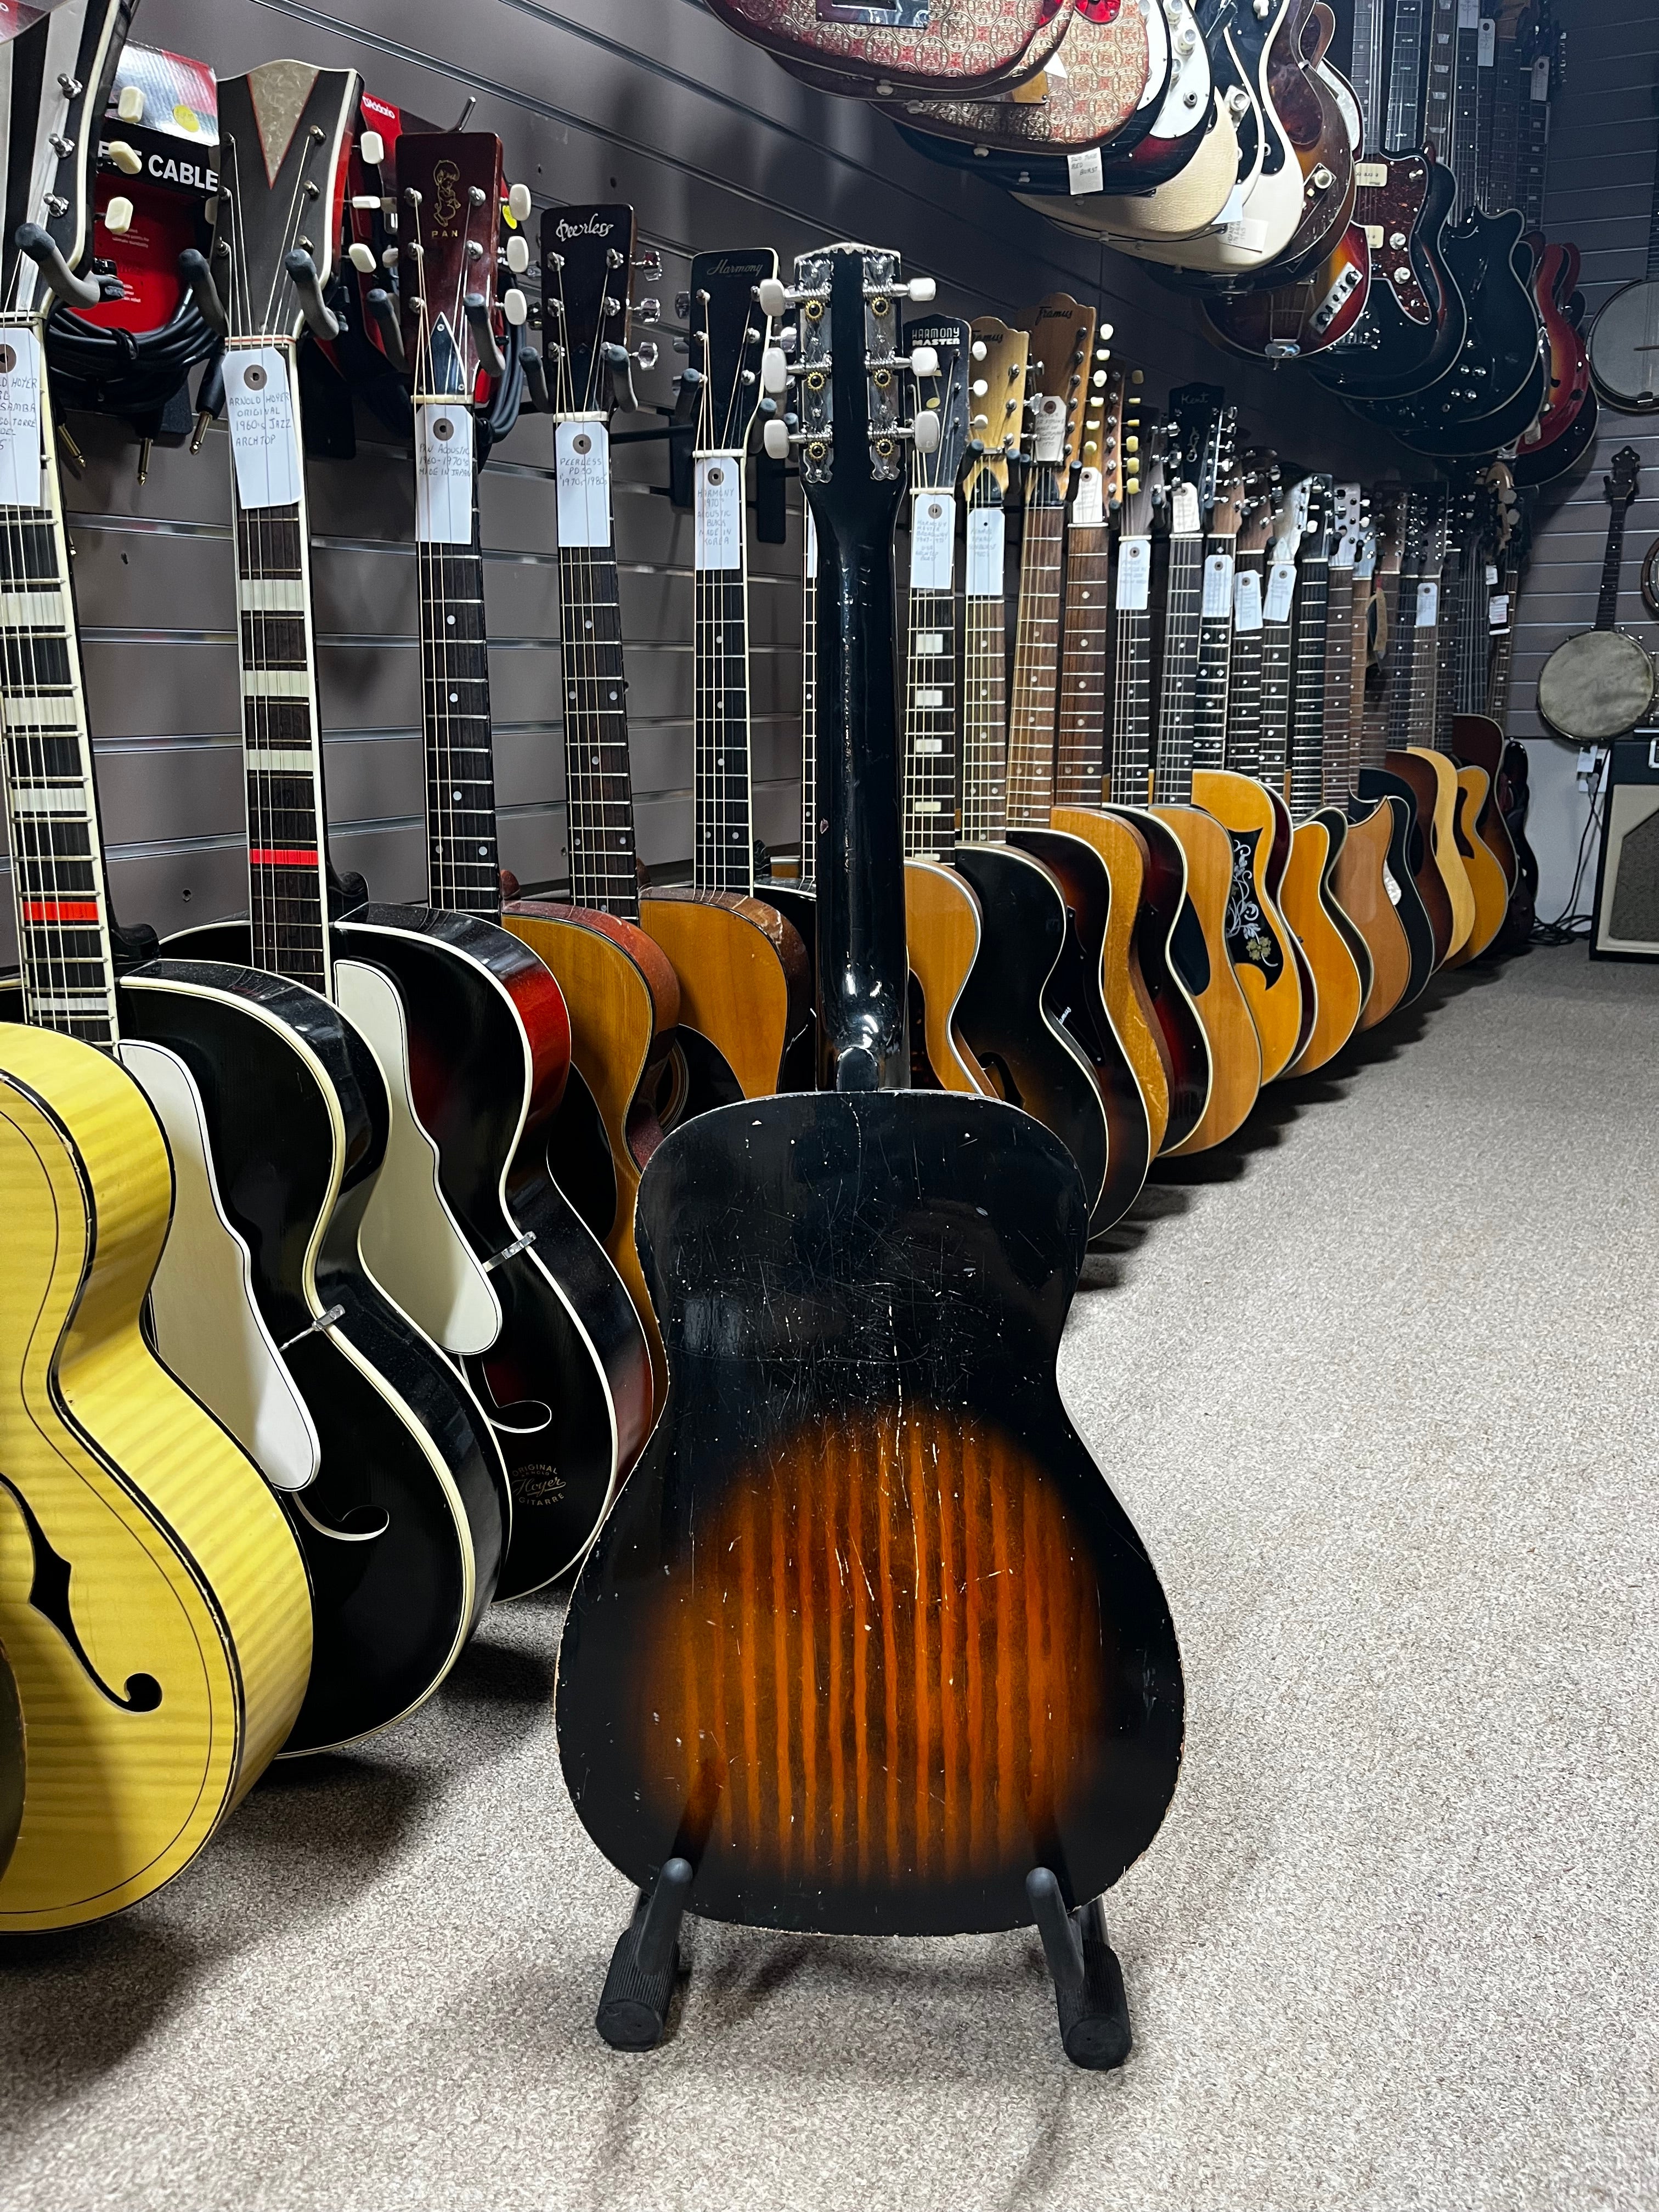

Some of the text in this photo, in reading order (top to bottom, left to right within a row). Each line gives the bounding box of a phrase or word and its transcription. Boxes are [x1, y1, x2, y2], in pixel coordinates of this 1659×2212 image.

[148, 155, 218, 192] CABLE
[556, 213, 614, 242] Peerless
[707, 259, 764, 276] Harmony
[1035, 306, 1073, 326] Framus
[912, 328, 960, 338] HARMONY
[912, 338, 960, 347] MASTER
[11, 377, 37, 389] HOYER
[229, 392, 290, 406] ARNOLD HOYER
[0, 402, 36, 413] SAMBA
[237, 407, 280, 417] ORIGINAL
[269, 418, 291, 429] JAZZ
[236, 434, 276, 447] ARCHTOP
[560, 458, 602, 466] PEERLESS
[512, 1464, 557, 1476] ORIGINAL
[511, 1476, 566, 1498] Hoyer
[518, 1493, 565, 1505] GITARRE
